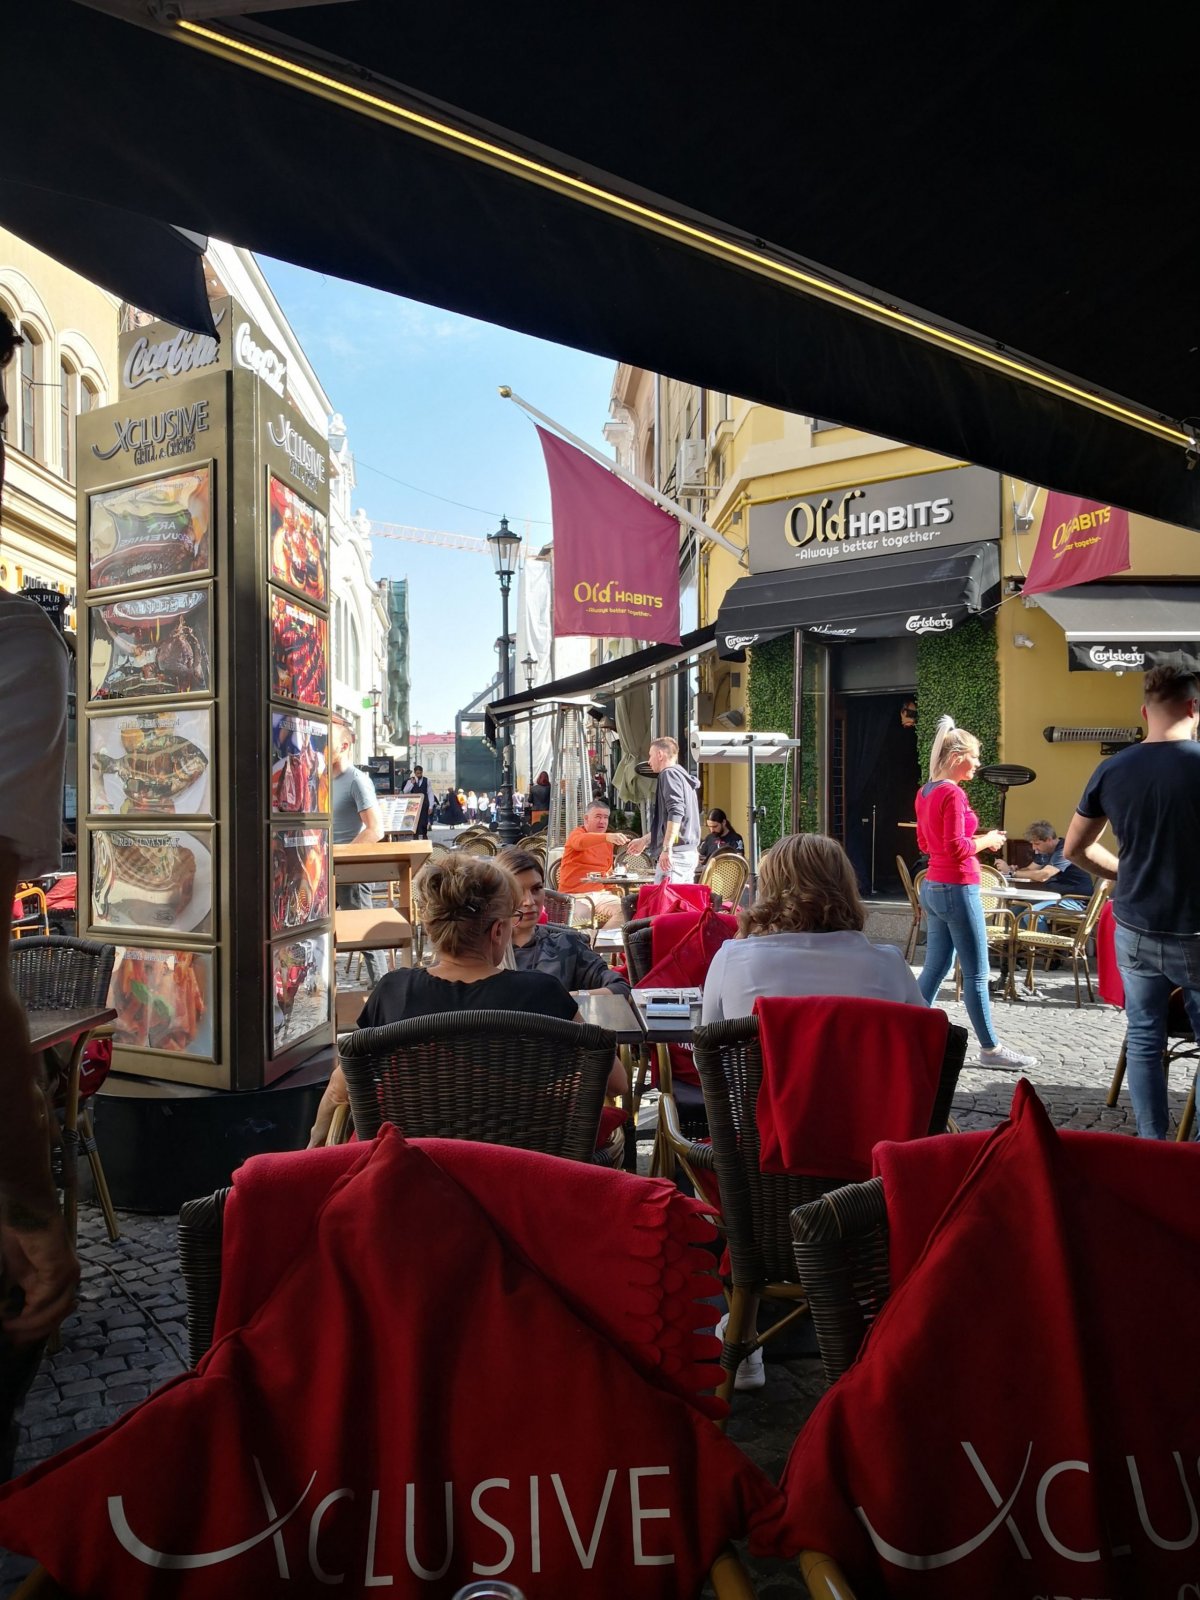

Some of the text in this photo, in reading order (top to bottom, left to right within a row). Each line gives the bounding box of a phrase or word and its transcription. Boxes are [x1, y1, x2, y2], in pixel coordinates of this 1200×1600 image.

[91, 400, 208, 460] XCLUSIVE
[784, 489, 952, 547] Old HABITS
[842, 538, 878, 553] better
[42, 594, 60, 603] PUB
[573, 580, 663, 608] Old HABITS
[906, 613, 953, 635] Carlsberg
[1089, 646, 1145, 668] Carlsberg
[107, 1453, 675, 1587] XCLUSIVE
